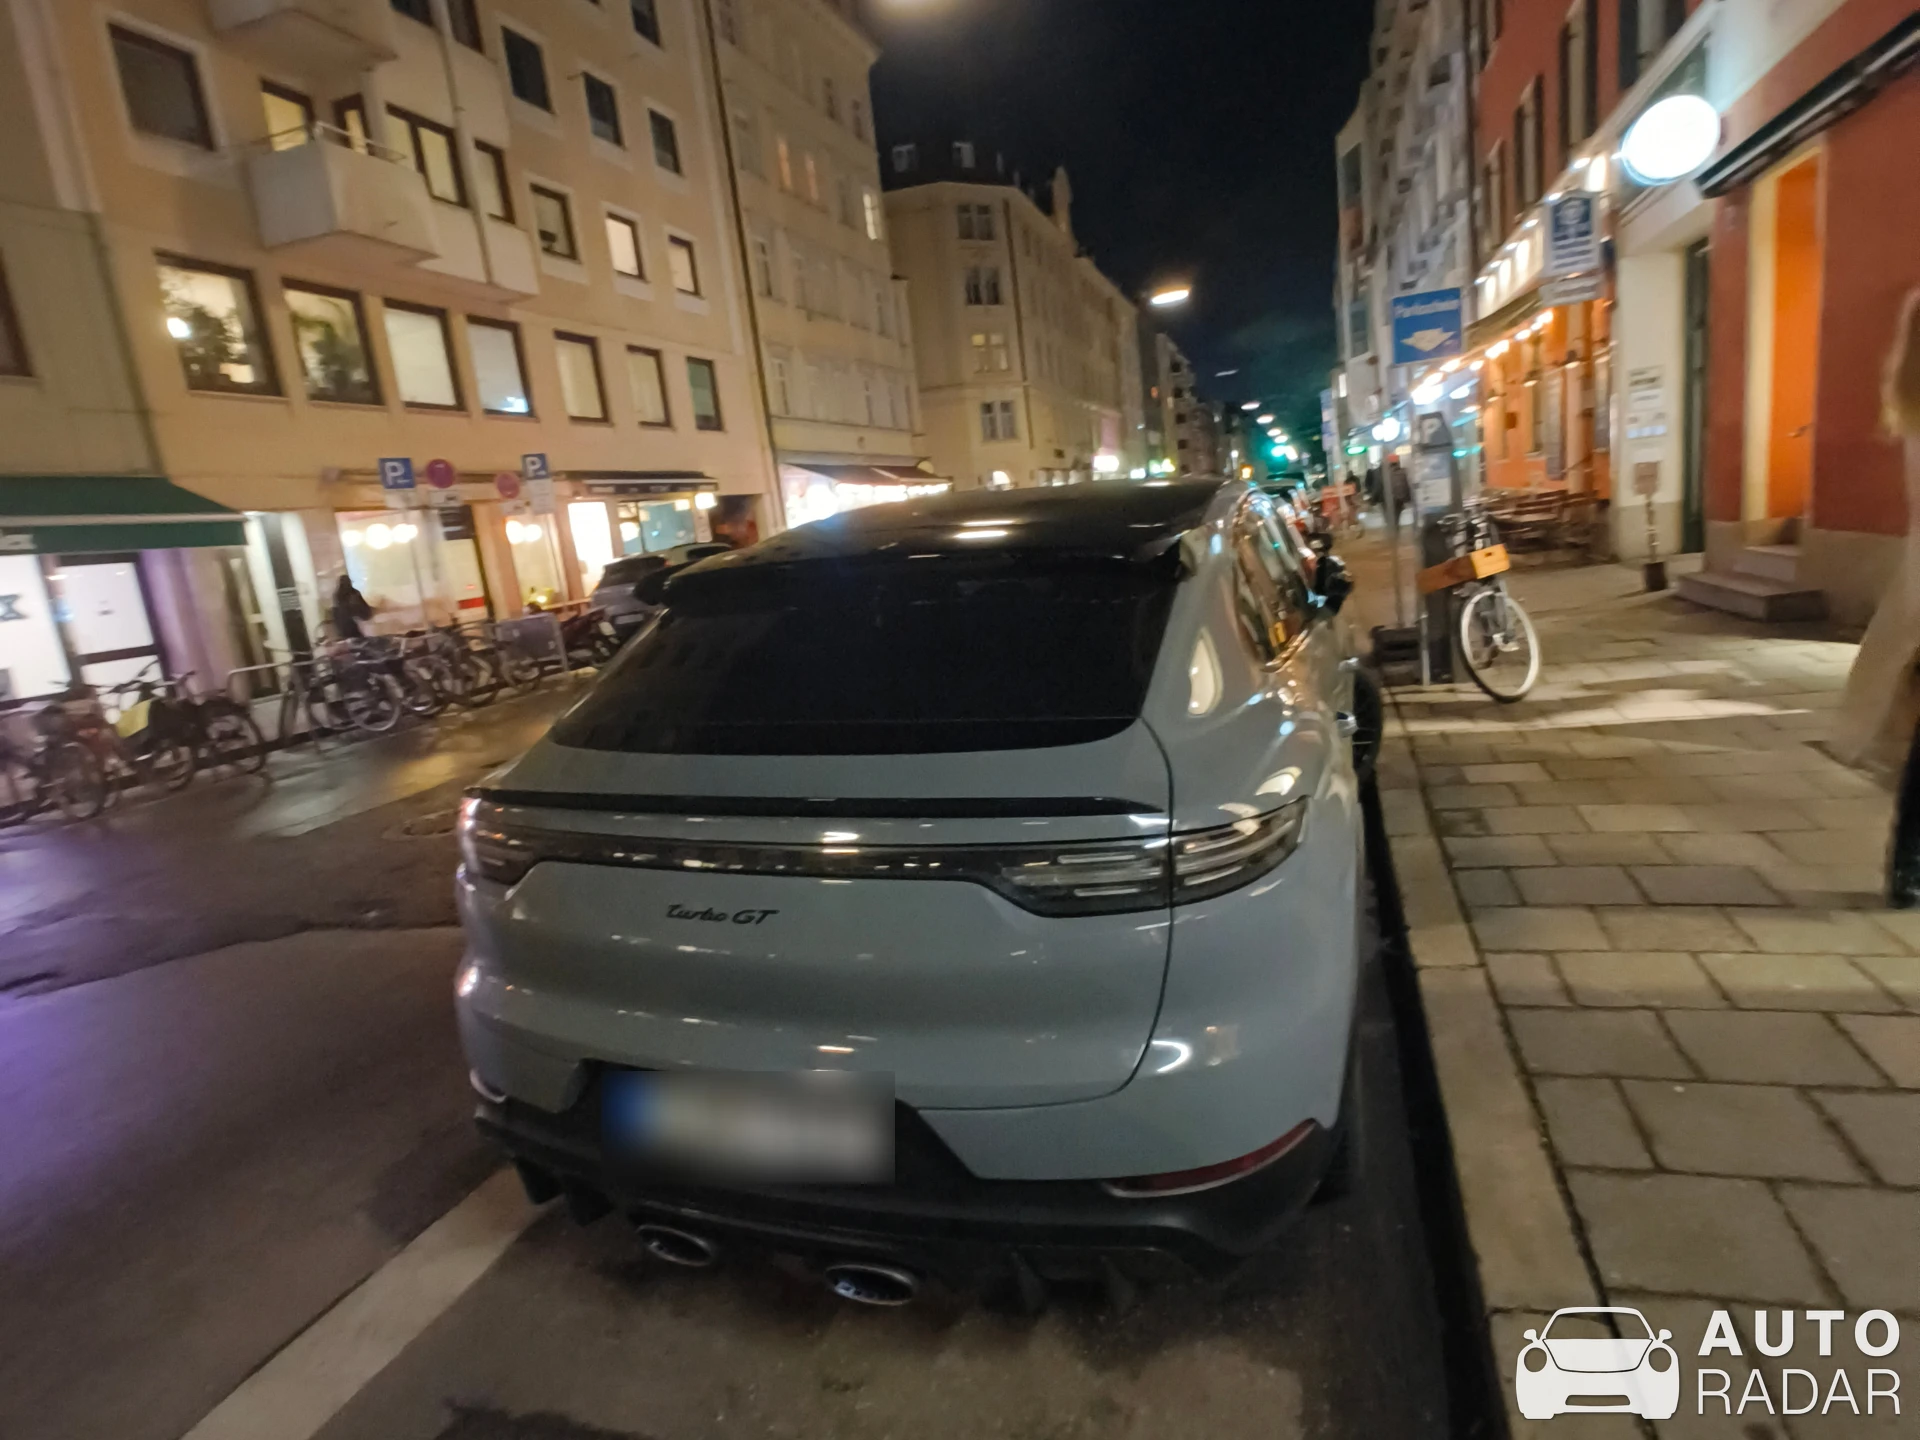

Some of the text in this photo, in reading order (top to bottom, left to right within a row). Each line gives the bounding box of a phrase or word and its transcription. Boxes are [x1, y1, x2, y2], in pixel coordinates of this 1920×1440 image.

[384, 461, 404, 486] P
[527, 456, 541, 478] P
[666, 904, 780, 925] turbo GT
